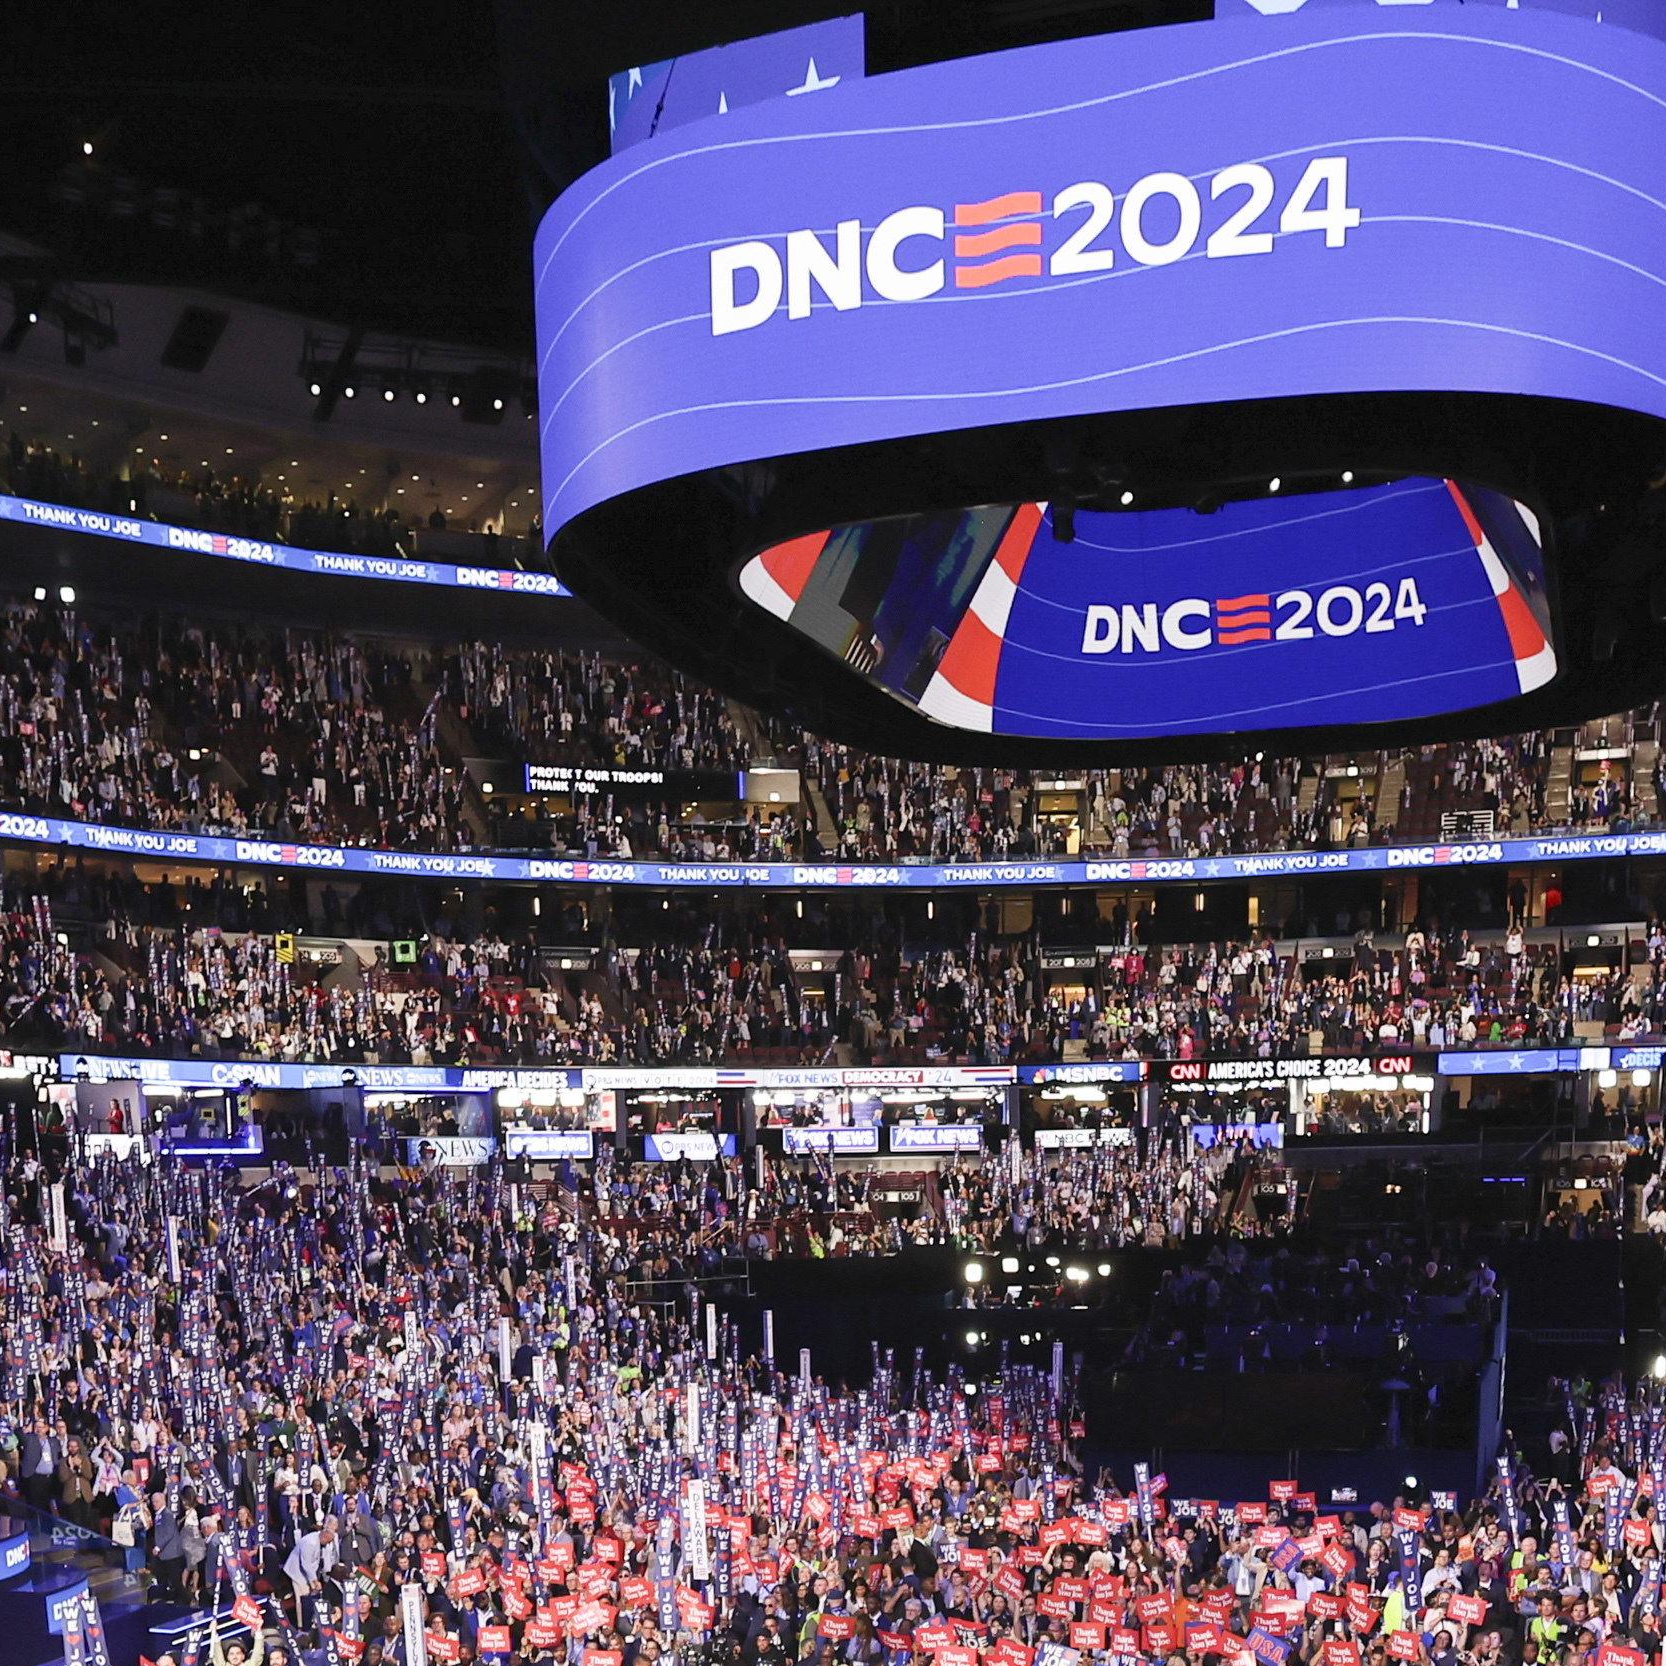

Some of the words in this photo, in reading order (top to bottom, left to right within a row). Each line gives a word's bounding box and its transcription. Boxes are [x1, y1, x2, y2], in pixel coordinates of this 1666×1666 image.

[1170, 1063, 1201, 1080] CNN
[1208, 1061, 1274, 1079] AMERICA'S
[1276, 1059, 1321, 1077] CHOICE
[1323, 1057, 1373, 1076] 2024
[1379, 1056, 1412, 1073] CNN
[358, 1069, 403, 1085] NEWS
[462, 1070, 515, 1088] AMERICA
[517, 1071, 568, 1088] DECIDES
[779, 1073, 801, 1084] FOX
[804, 1073, 838, 1083] NEWS
[843, 1071, 923, 1084] DEMOCRACY
[1055, 1066, 1123, 1083] MSNBC
[910, 1129, 936, 1145] FOX
[939, 1129, 980, 1145] NEWS
[434, 1140, 489, 1158] NEWS
